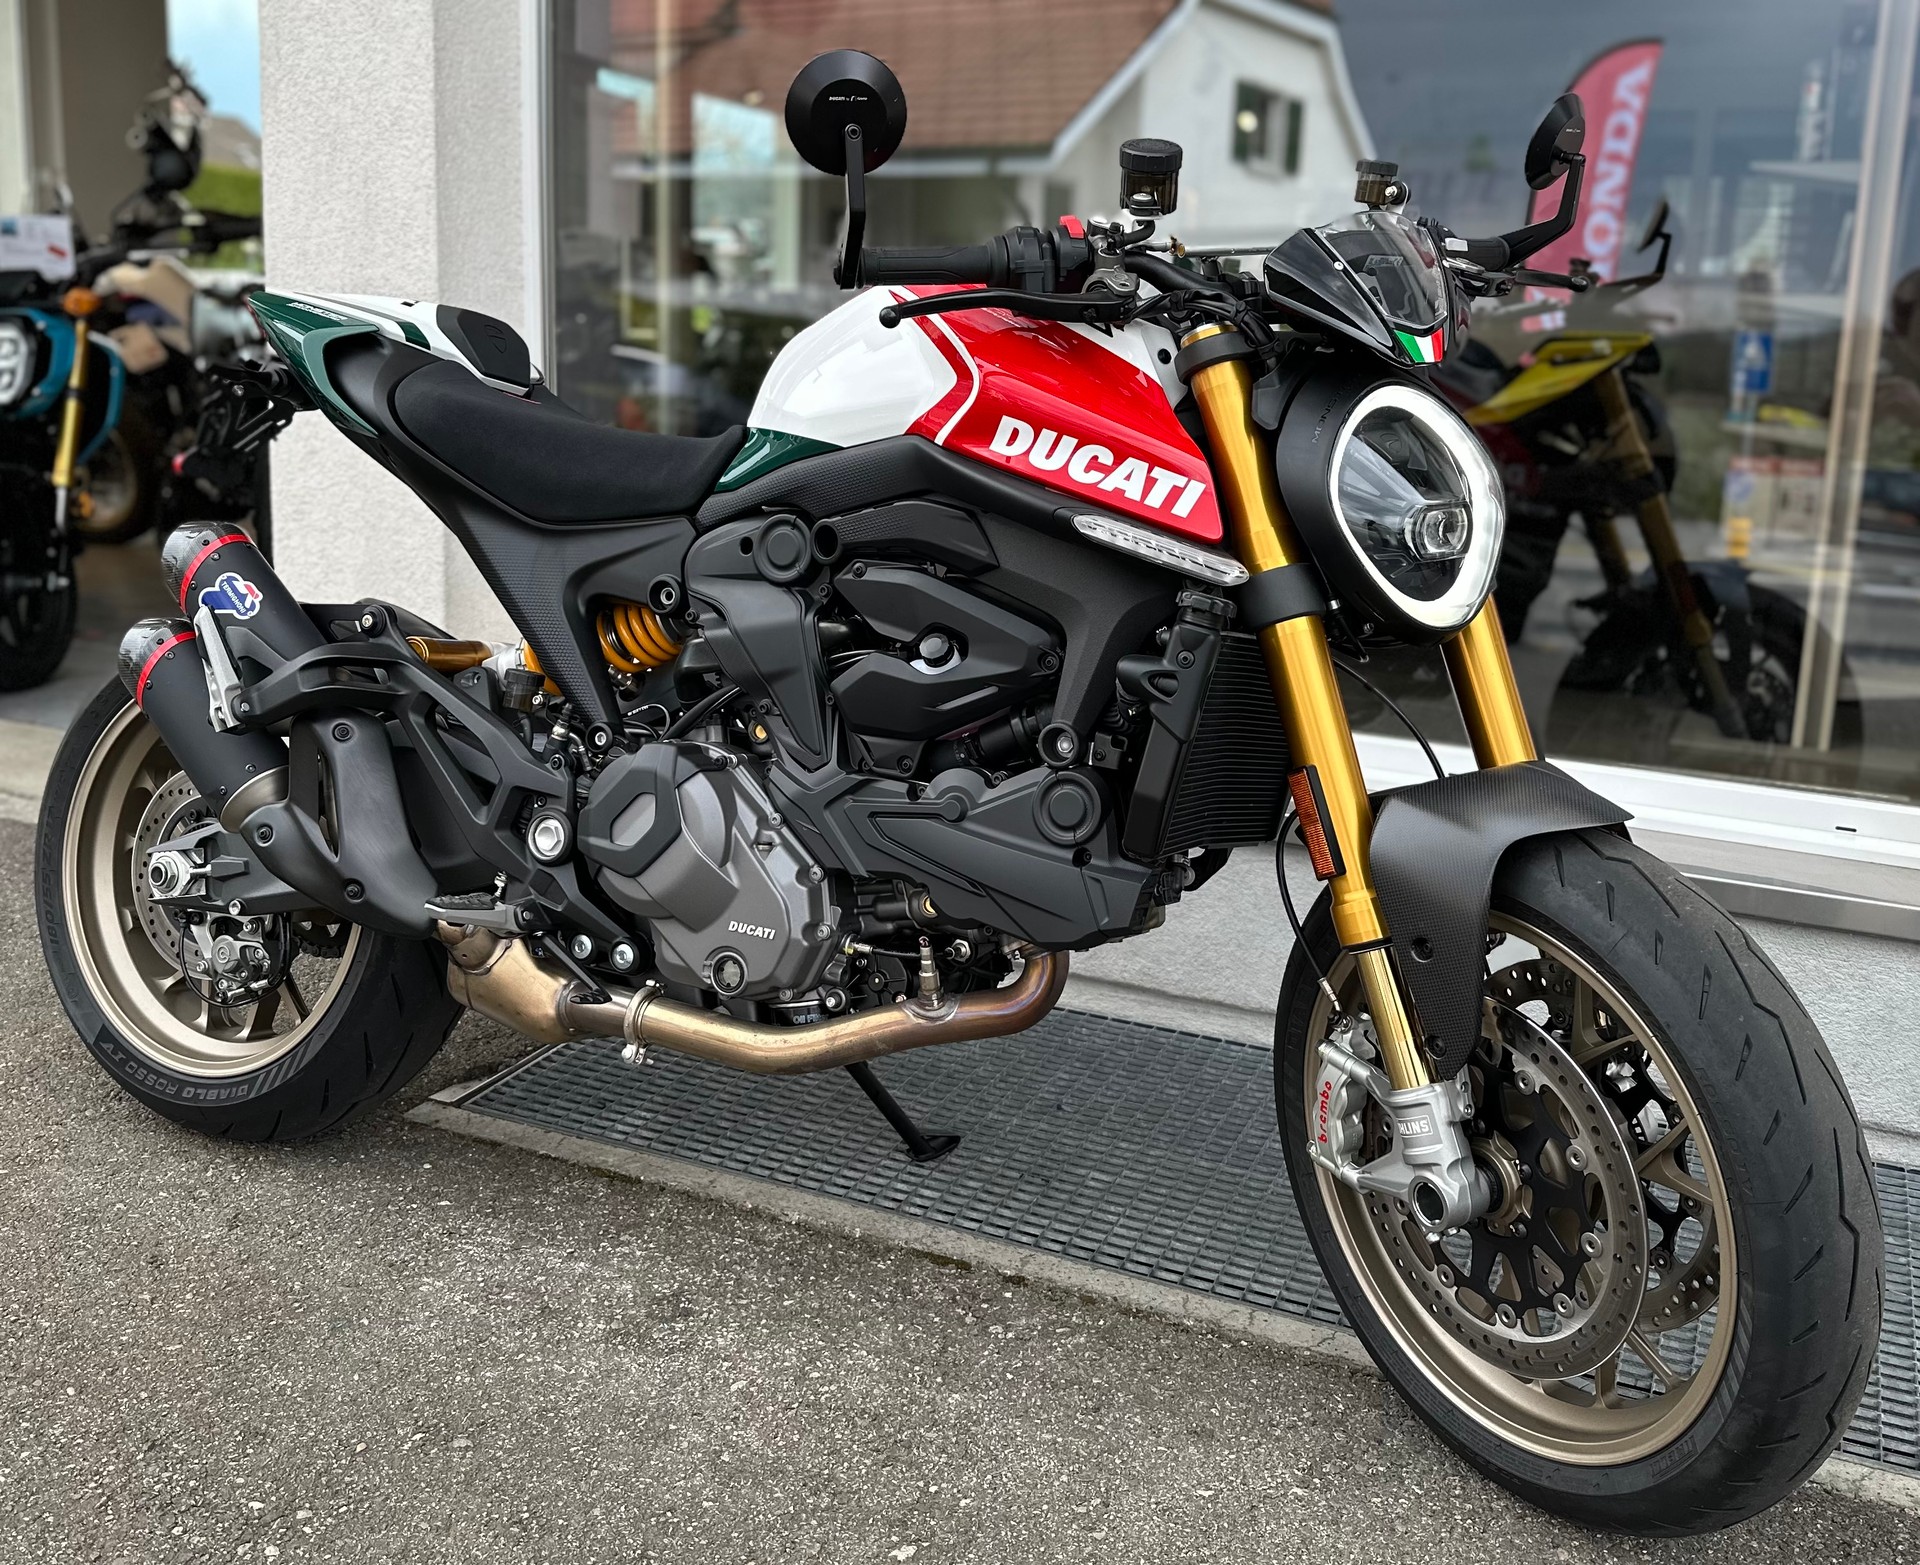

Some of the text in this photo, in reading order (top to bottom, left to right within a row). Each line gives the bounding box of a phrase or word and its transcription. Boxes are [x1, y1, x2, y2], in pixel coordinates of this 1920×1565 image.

[989, 414, 1207, 519] DUCATI
[728, 920, 776, 940] DUCATI
[124, 1062, 179, 1095] ROSSO
[181, 1082, 250, 1100] DIABLO
[1317, 1080, 1333, 1144] brembo
[1397, 1119, 1430, 1135] HLINS
